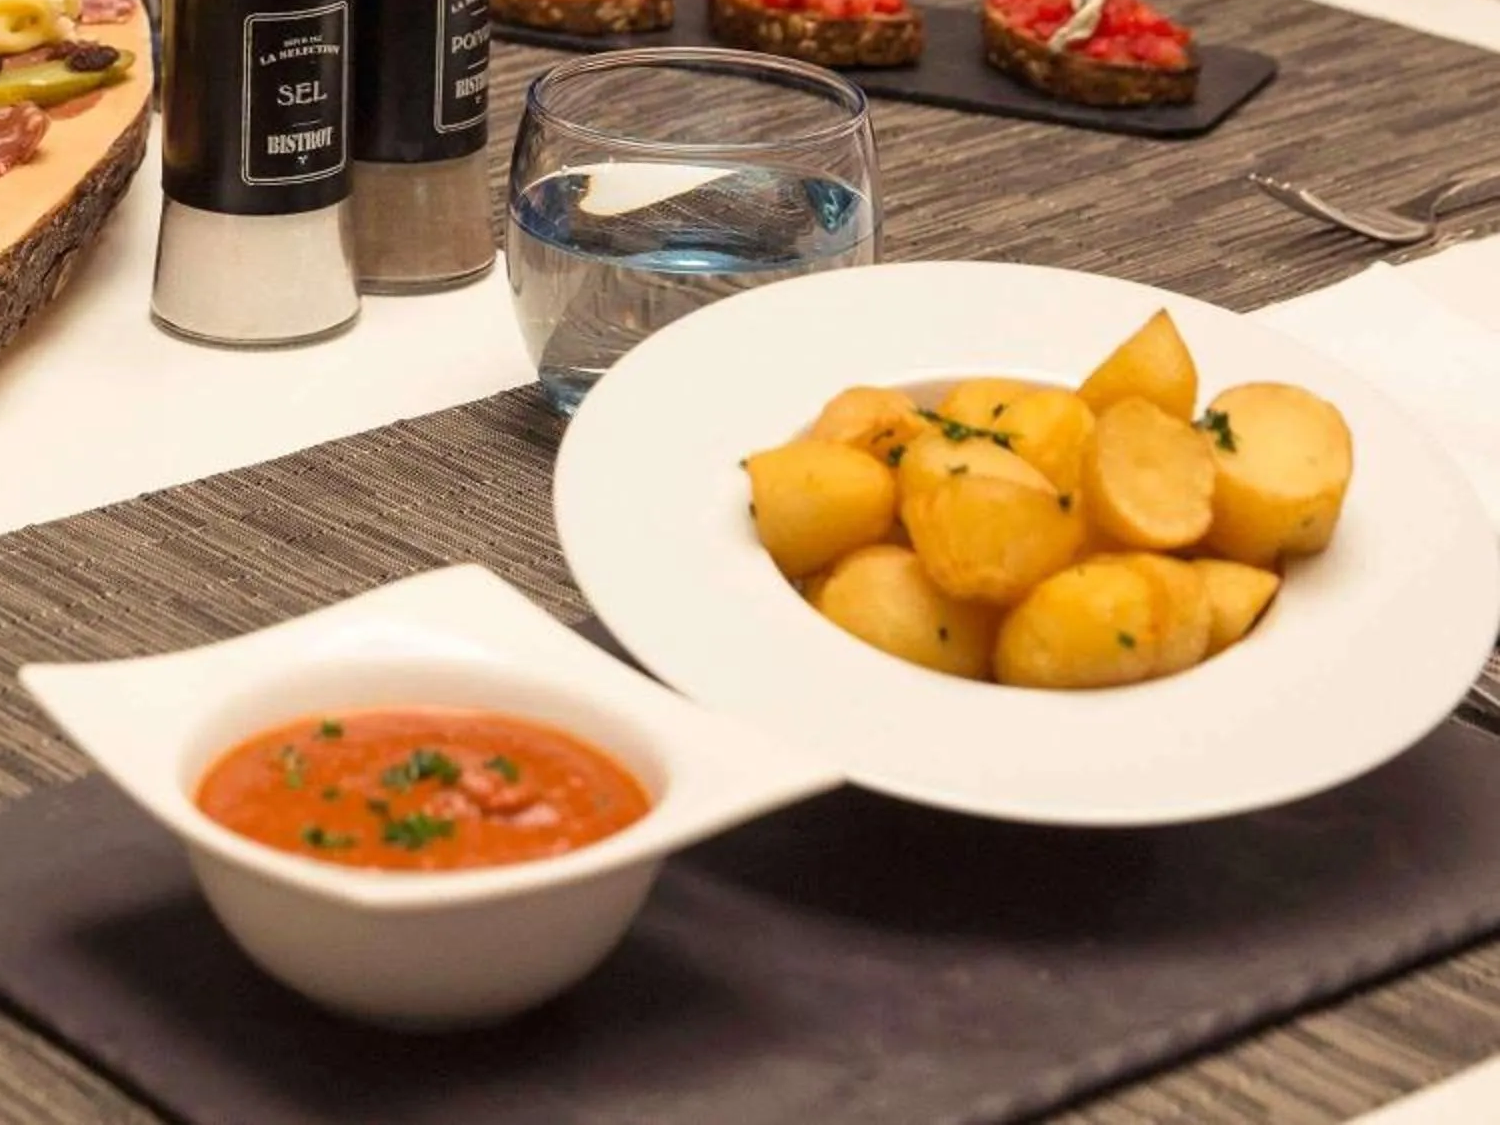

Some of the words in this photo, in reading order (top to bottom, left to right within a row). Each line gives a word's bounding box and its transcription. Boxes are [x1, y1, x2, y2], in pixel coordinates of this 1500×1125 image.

[260, 53, 277, 66] LA
[276, 81, 328, 106] SEL
[267, 127, 333, 155] BISTROT
